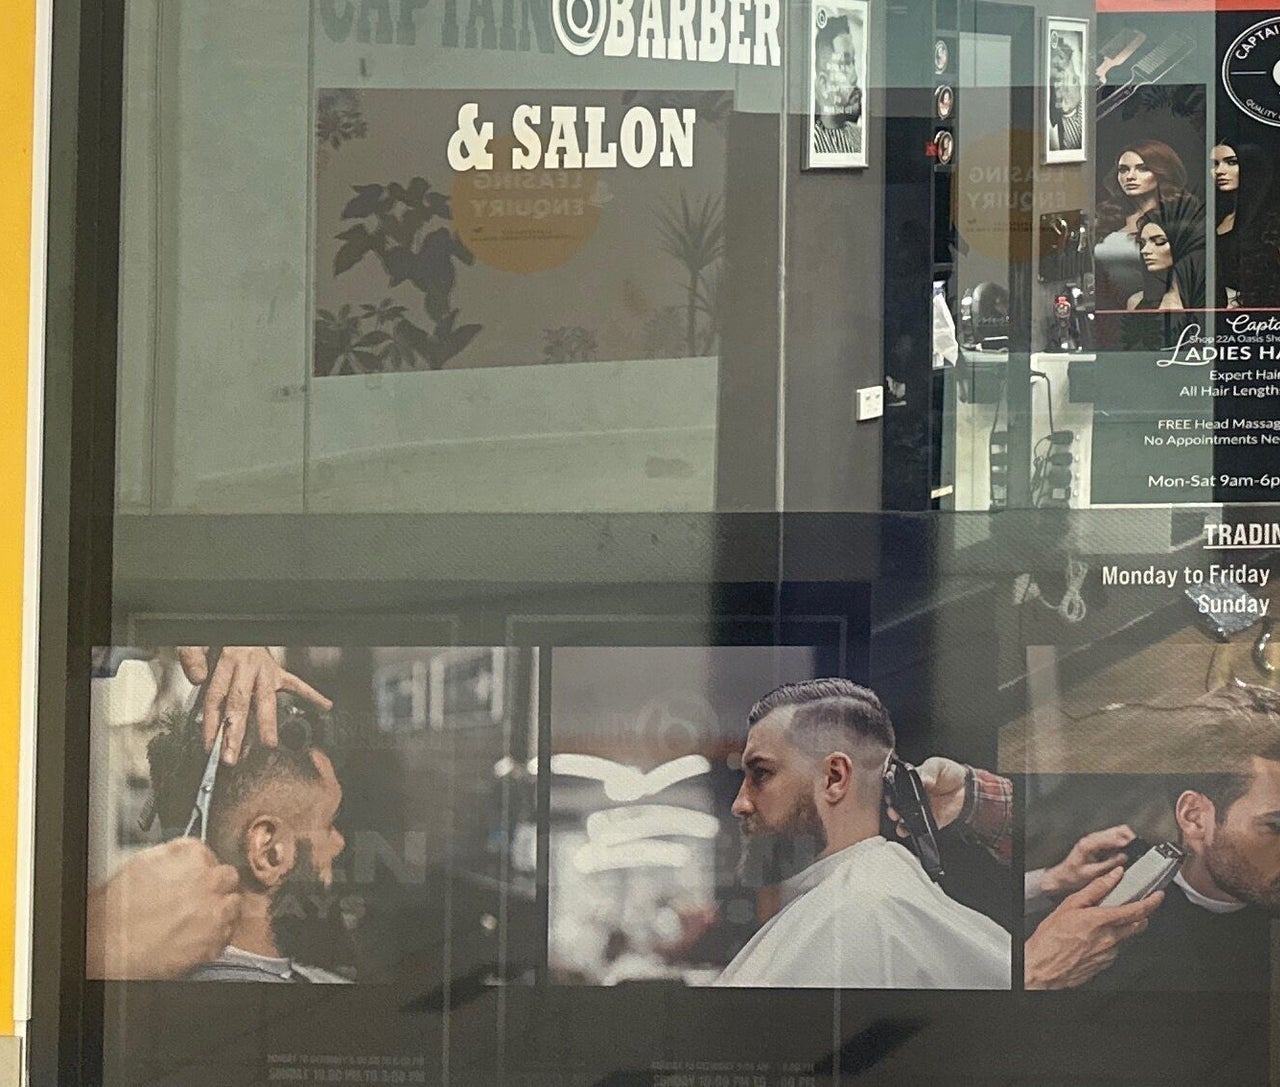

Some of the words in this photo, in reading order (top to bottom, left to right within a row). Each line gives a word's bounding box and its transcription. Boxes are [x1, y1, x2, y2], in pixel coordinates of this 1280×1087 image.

[1245, 97, 1278, 121] QUALITY
[447, 103, 494, 172] &
[512, 104, 697, 170] SALON
[1189, 335, 1214, 344] Shop
[1216, 334, 1235, 343] 22A
[1237, 334, 1264, 343] Oasis
[1209, 368, 1252, 382] Expert
[1179, 384, 1198, 396] All
[1200, 384, 1230, 396] Hair
[1157, 419, 1191, 430] FREE
[1194, 418, 1229, 430] Head
[1143, 434, 1164, 446] No
[1165, 433, 1258, 448] Appointments
[1147, 475, 1216, 489] Mon-Sat
[1101, 565, 1177, 587] Monday
[1183, 566, 1202, 585] to
[1208, 564, 1270, 586] Friday
[1197, 594, 1270, 617] Sunday
